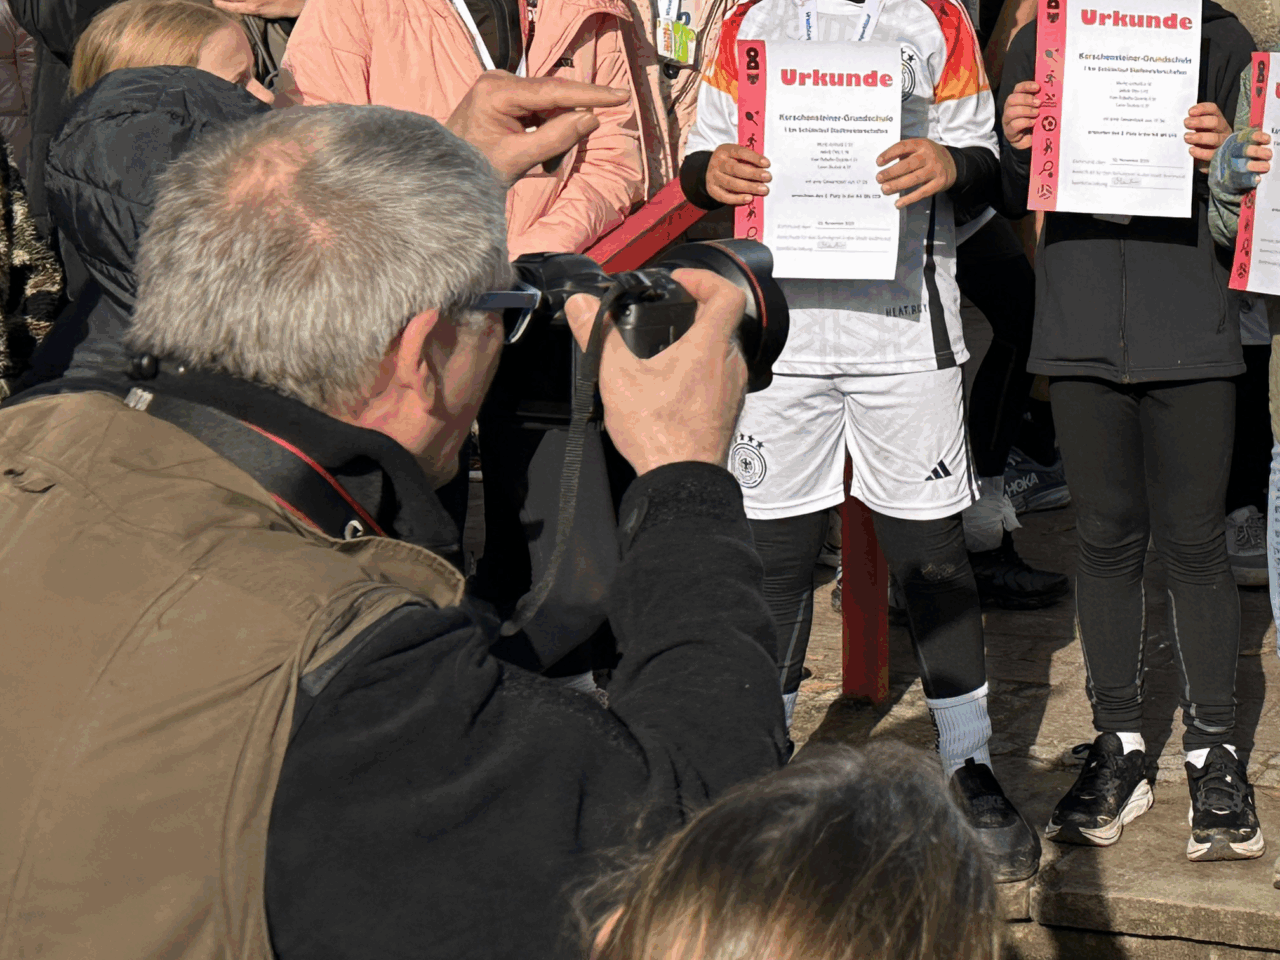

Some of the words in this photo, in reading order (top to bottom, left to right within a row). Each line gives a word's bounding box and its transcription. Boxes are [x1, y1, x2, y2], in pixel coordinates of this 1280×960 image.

[1081, 9, 1193, 30] Urkunde
[780, 68, 893, 87] Urkunde
[1005, 472, 1039, 497] HOKA
